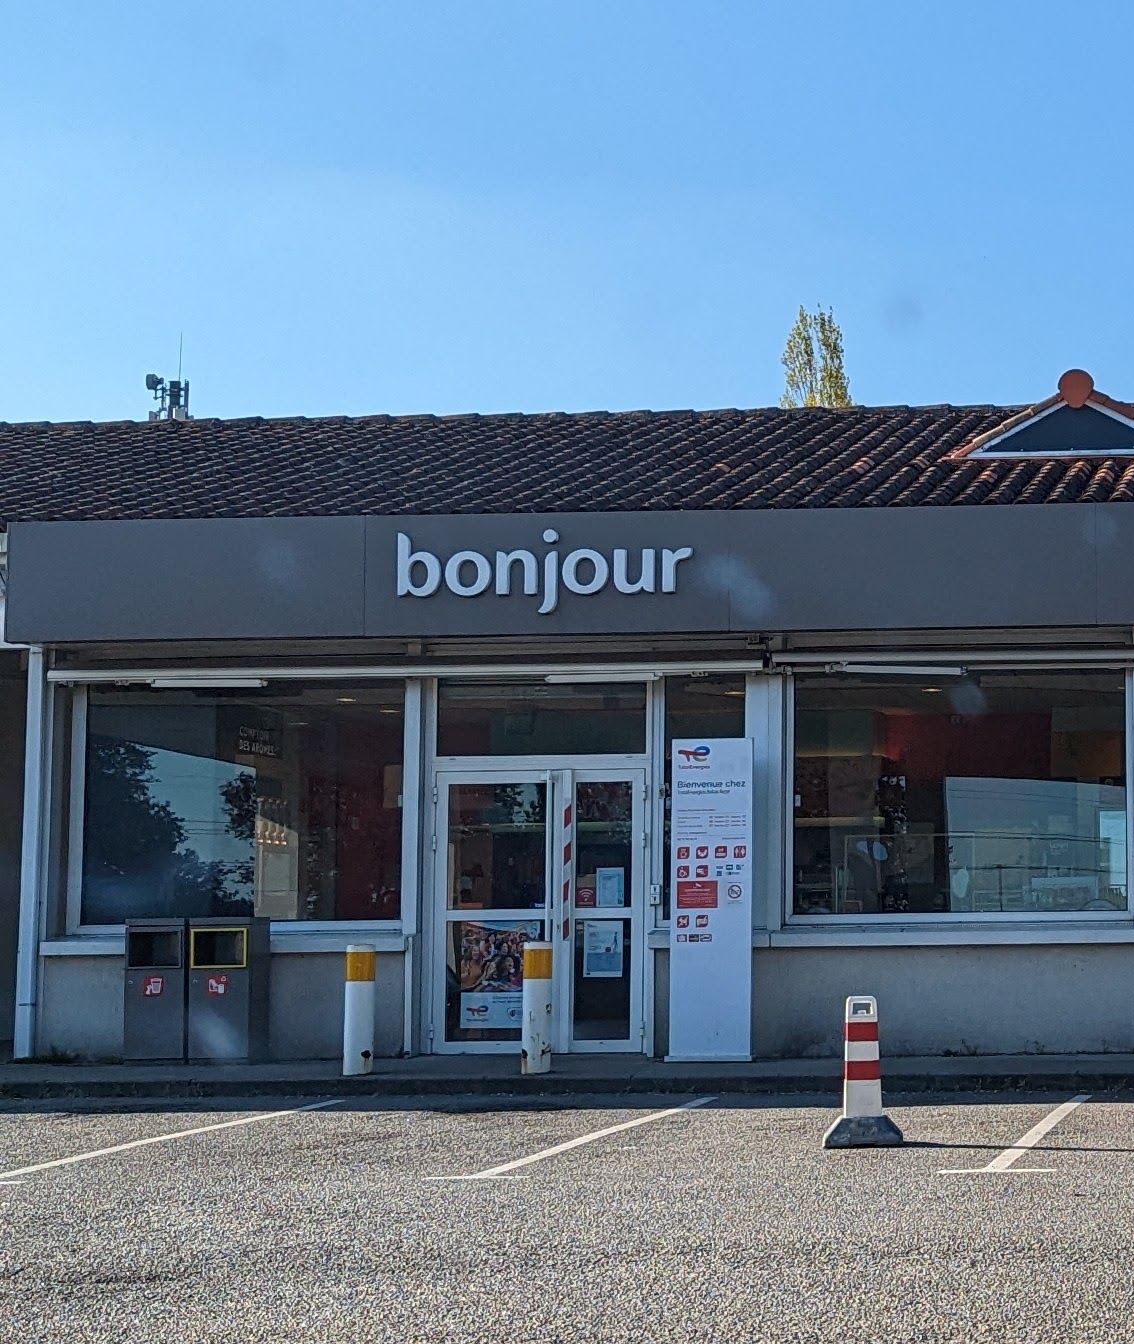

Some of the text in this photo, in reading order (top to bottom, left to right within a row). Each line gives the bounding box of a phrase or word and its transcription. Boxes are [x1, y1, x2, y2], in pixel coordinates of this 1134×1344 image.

[396, 529, 694, 615] bonjour
[677, 779, 747, 789] Bienvenue chez
